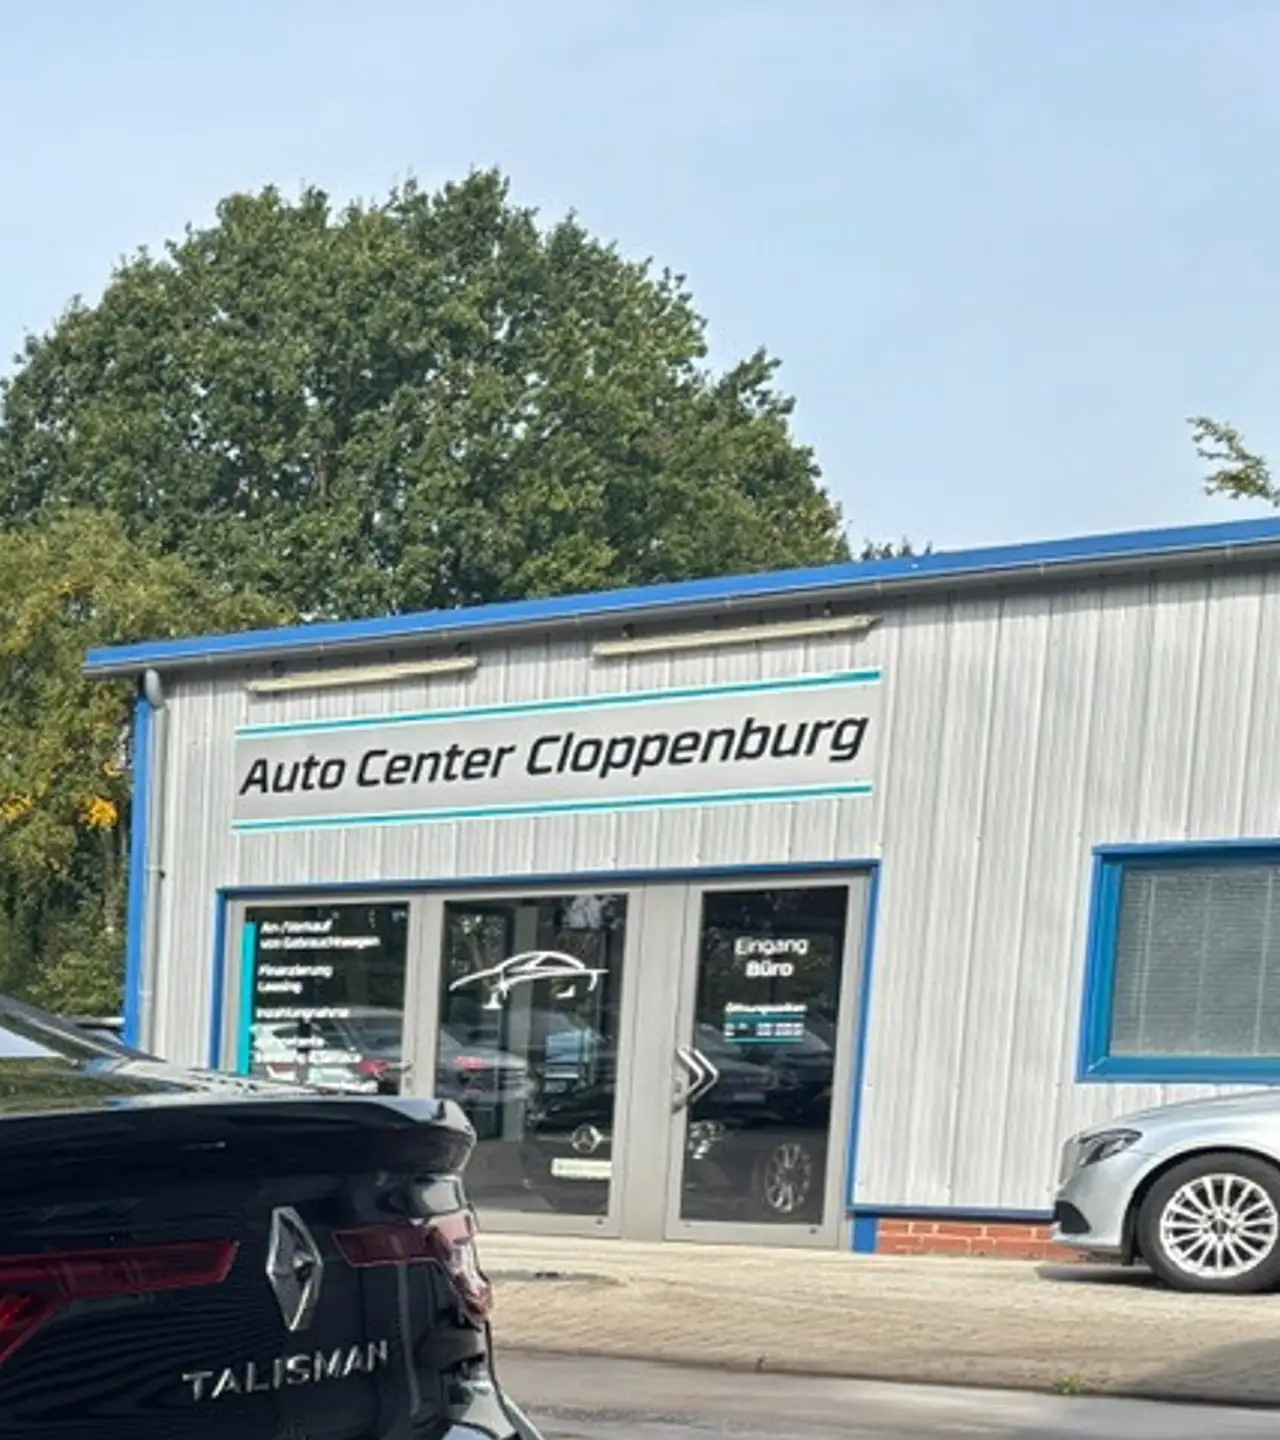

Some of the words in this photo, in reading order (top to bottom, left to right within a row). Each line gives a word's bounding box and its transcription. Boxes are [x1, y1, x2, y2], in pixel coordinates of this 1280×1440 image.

[239, 755, 346, 796] Auto
[356, 741, 516, 787] Center
[526, 716, 870, 777] Cloppenburg
[734, 936, 809, 955] Eingang
[745, 959, 794, 977] Büro
[181, 1340, 388, 1401] TALISMAN
